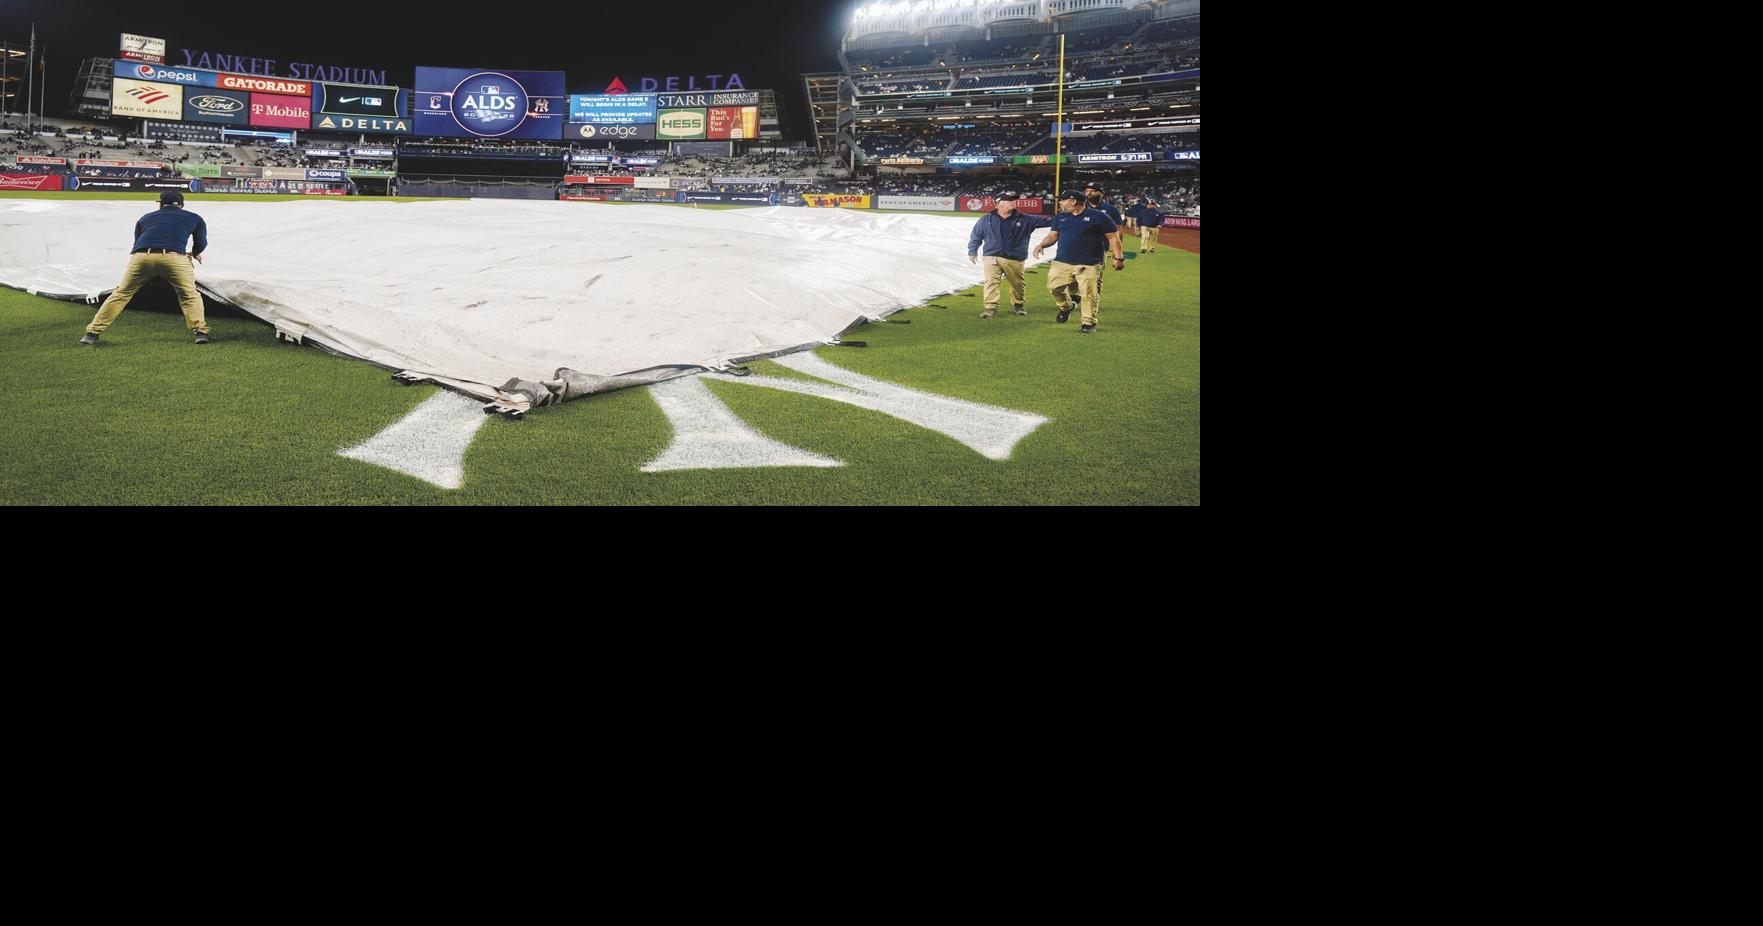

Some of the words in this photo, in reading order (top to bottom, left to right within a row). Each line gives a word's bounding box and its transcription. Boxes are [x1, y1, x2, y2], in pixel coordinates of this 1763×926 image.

[126, 52, 160, 60] ARMITRON
[181, 48, 276, 76] YANKEE
[288, 62, 387, 86] STADIUM
[157, 70, 198, 82] pepsi
[640, 73, 746, 92] DELTA
[224, 77, 306, 94] GATORADE
[462, 94, 515, 110] ALDS
[658, 95, 708, 106] STARR
[714, 92, 759, 100] INSURANCE
[199, 96, 234, 110] Ford
[266, 105, 310, 118] Mobile
[341, 118, 406, 130] DELTA
[662, 120, 702, 128] HESS
[600, 125, 637, 138] edge
